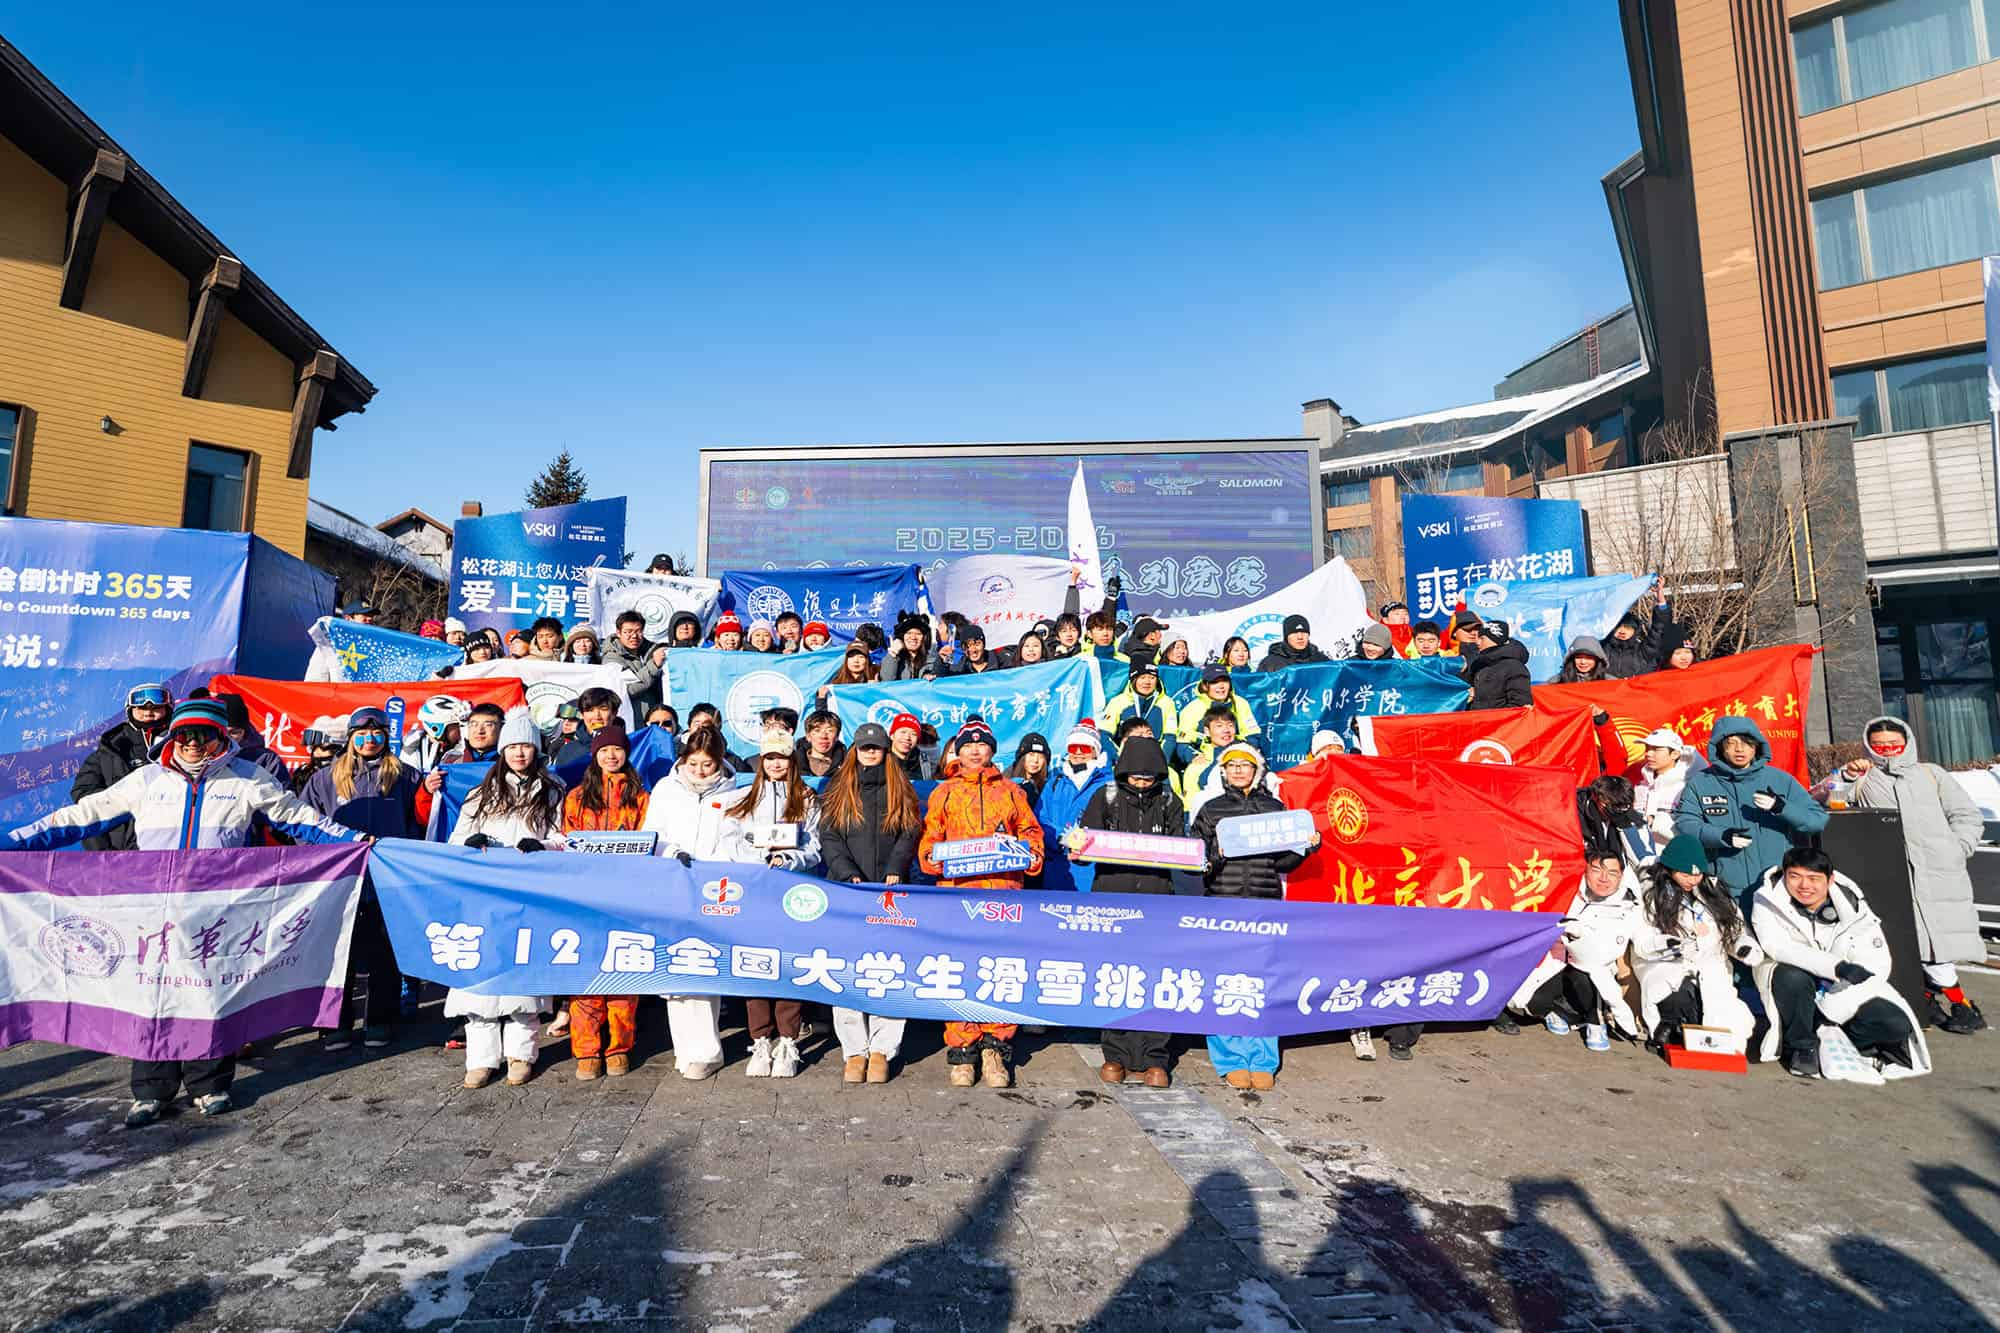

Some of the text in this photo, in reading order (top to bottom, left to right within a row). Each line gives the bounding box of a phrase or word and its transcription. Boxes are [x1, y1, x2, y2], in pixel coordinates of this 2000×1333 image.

[1219, 479, 1283, 488] SALOMON
[896, 526, 1115, 552] 2025-206
[18, 601, 115, 617] Countdown
[119, 607, 147, 620] 365
[152, 607, 190, 621] days
[996, 858, 1027, 869] CALL
[1178, 915, 1289, 936] SALOMON
[135, 954, 300, 988] Tsinghua University
